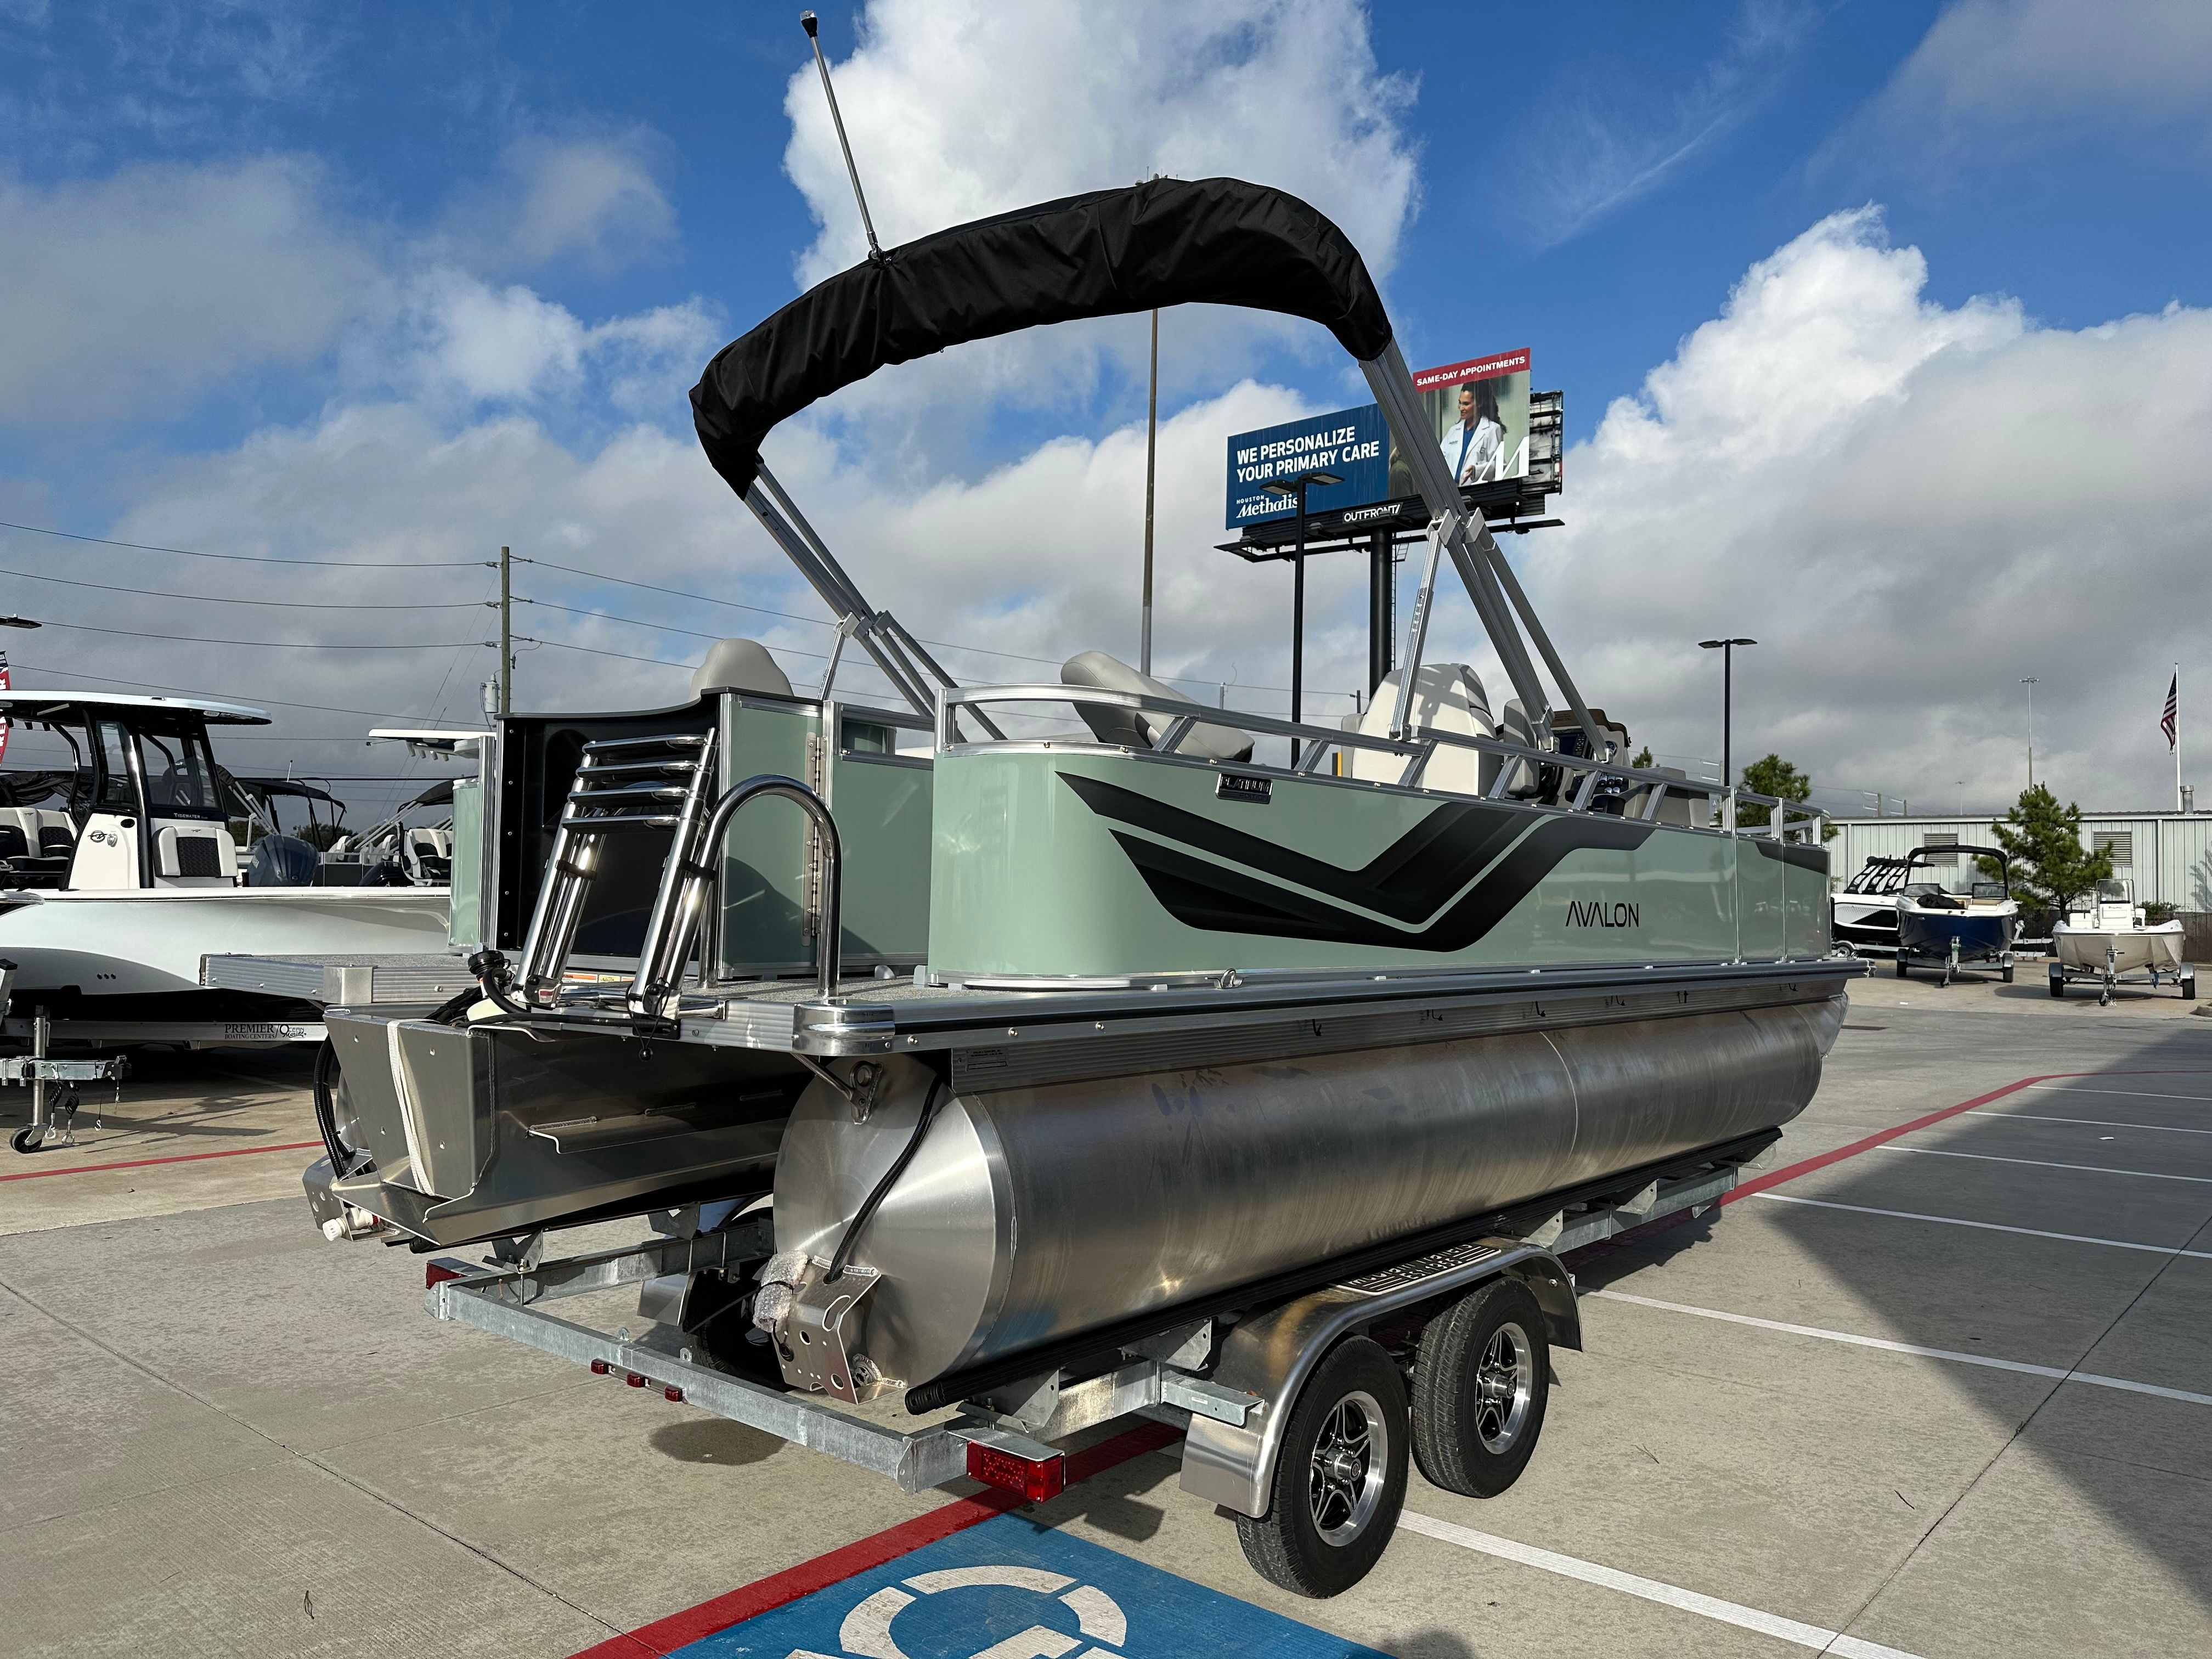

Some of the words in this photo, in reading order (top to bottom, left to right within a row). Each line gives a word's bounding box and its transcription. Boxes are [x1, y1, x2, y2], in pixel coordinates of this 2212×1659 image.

[1417, 370, 1458, 386] SAME-DAY
[1460, 356, 1525, 376] APPOINTMENTS
[1237, 447, 1257, 465] WE
[1261, 426, 1355, 460] PERSONALIZE
[1237, 462, 1273, 483] YOUR
[1276, 449, 1338, 476] PRIMARY
[1342, 441, 1380, 462] CARE
[1236, 495, 1265, 504] HOUSTON
[1236, 494, 1298, 518] Methodis
[1565, 901, 1639, 927] AVALON
[224, 1024, 275, 1033] PREMIER
[1425, 1258, 1463, 1271] 1955
